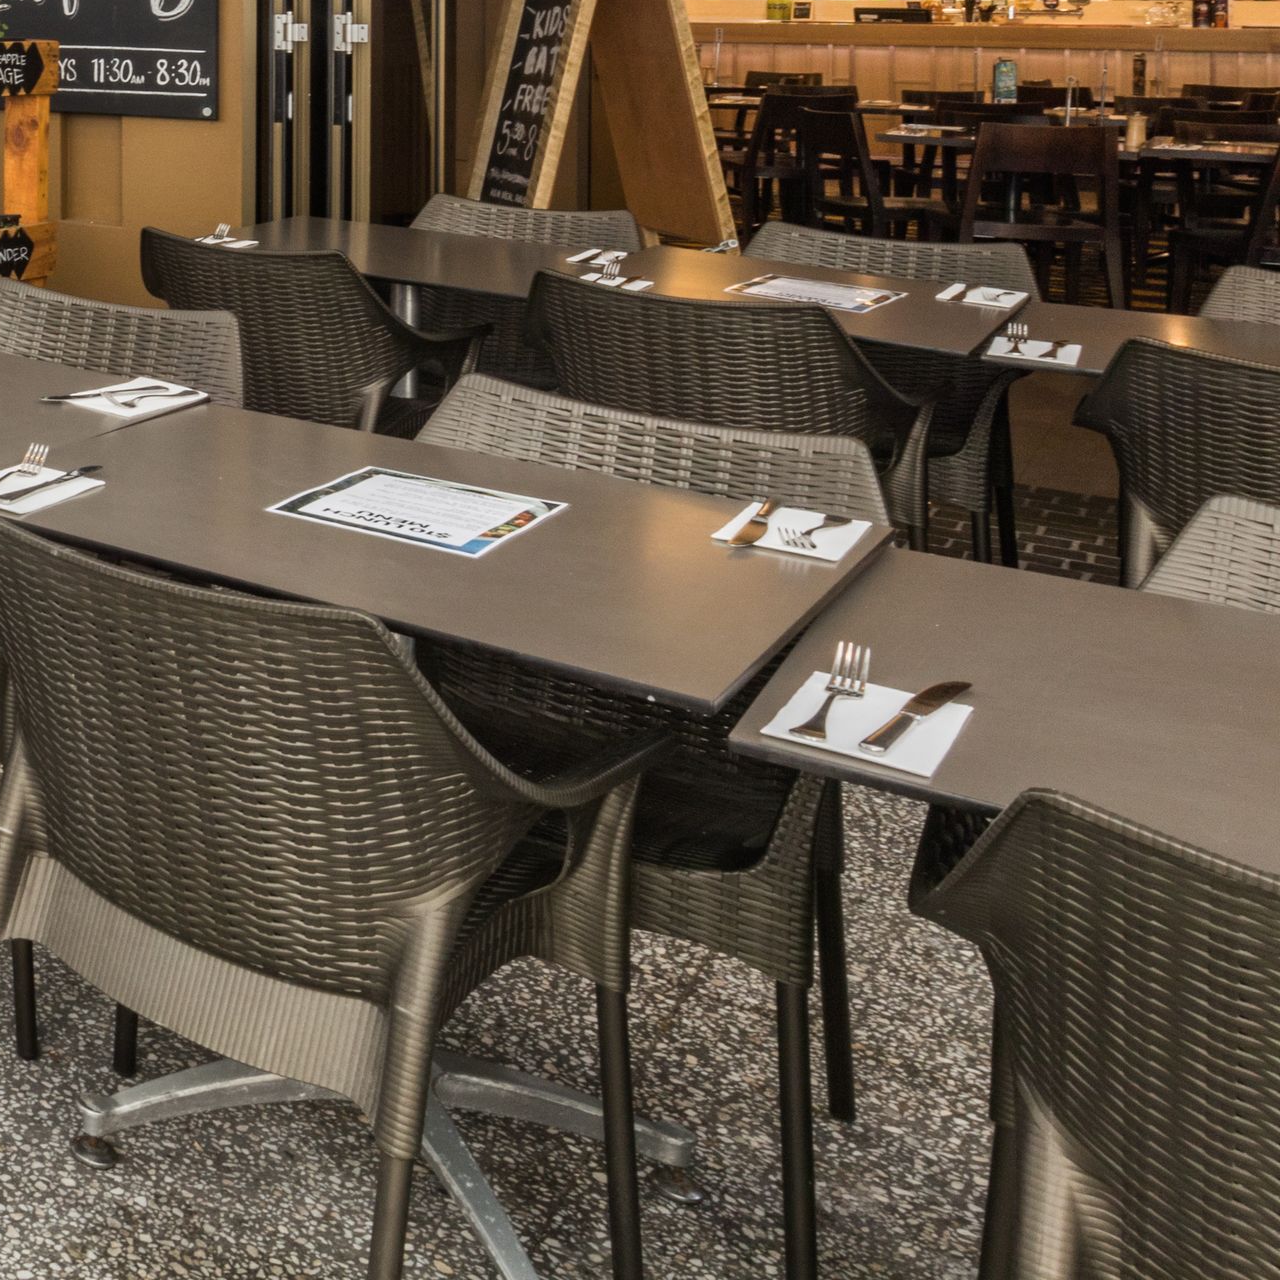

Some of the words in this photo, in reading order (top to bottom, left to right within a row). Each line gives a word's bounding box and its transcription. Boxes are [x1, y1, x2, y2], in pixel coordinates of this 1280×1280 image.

[58, 58, 77, 81] YS
[513, 84, 552, 114] FREE
[323, 508, 404, 529] LUNCH
[357, 511, 430, 528] MENU
